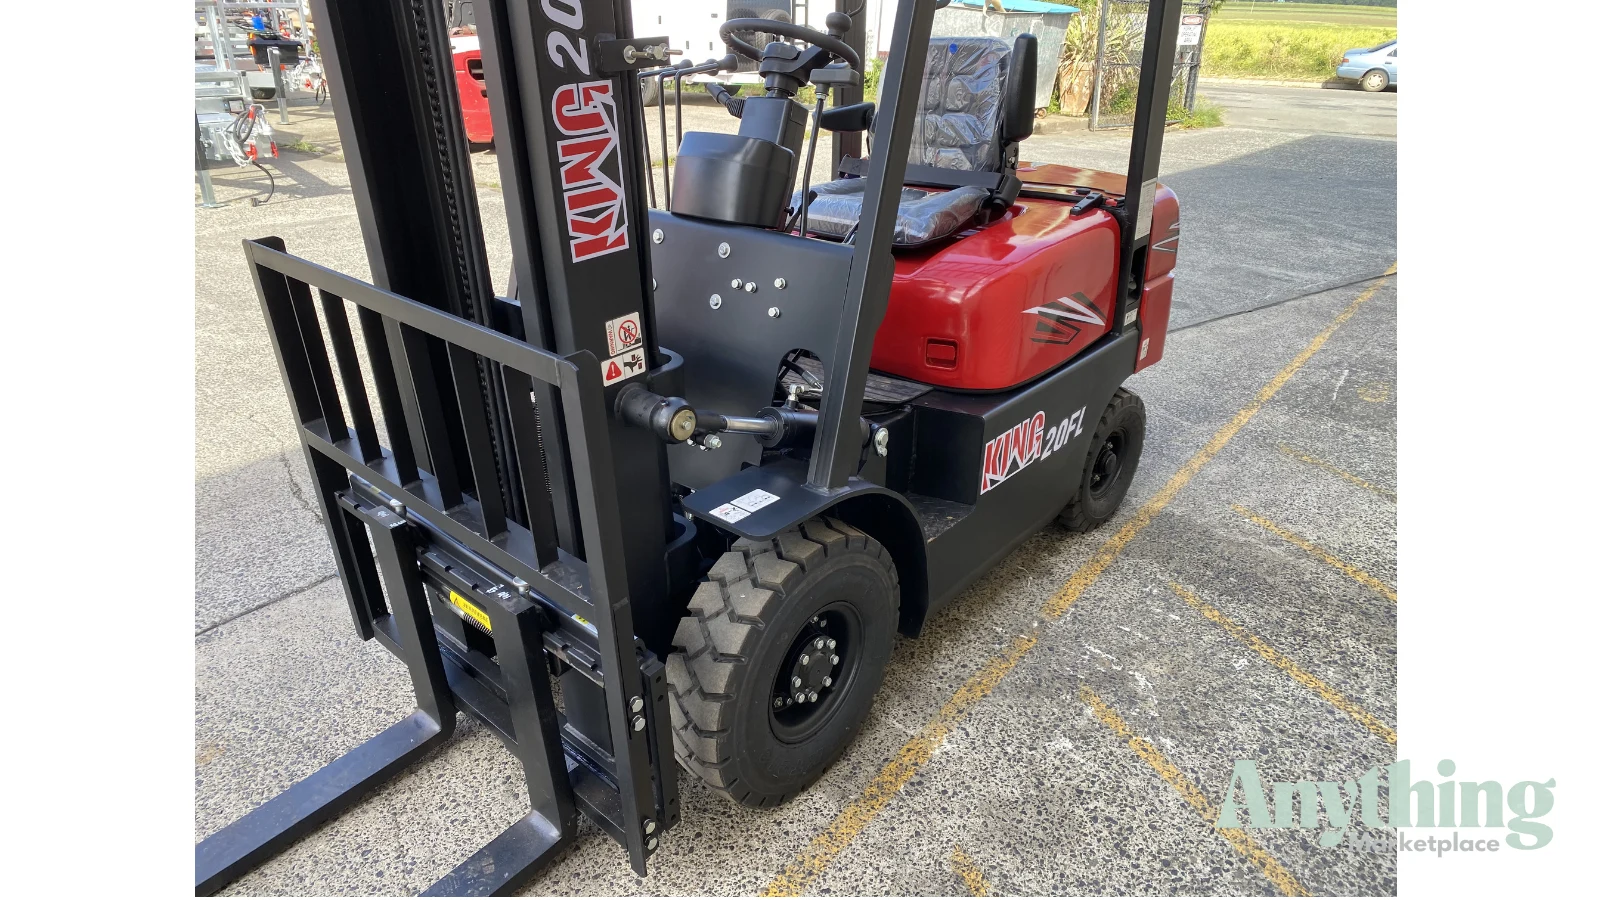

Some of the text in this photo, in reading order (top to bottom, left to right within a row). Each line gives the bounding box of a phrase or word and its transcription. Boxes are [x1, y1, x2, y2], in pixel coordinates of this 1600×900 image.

[551, 79, 629, 264] KING
[980, 405, 1087, 495] KING 20FL
